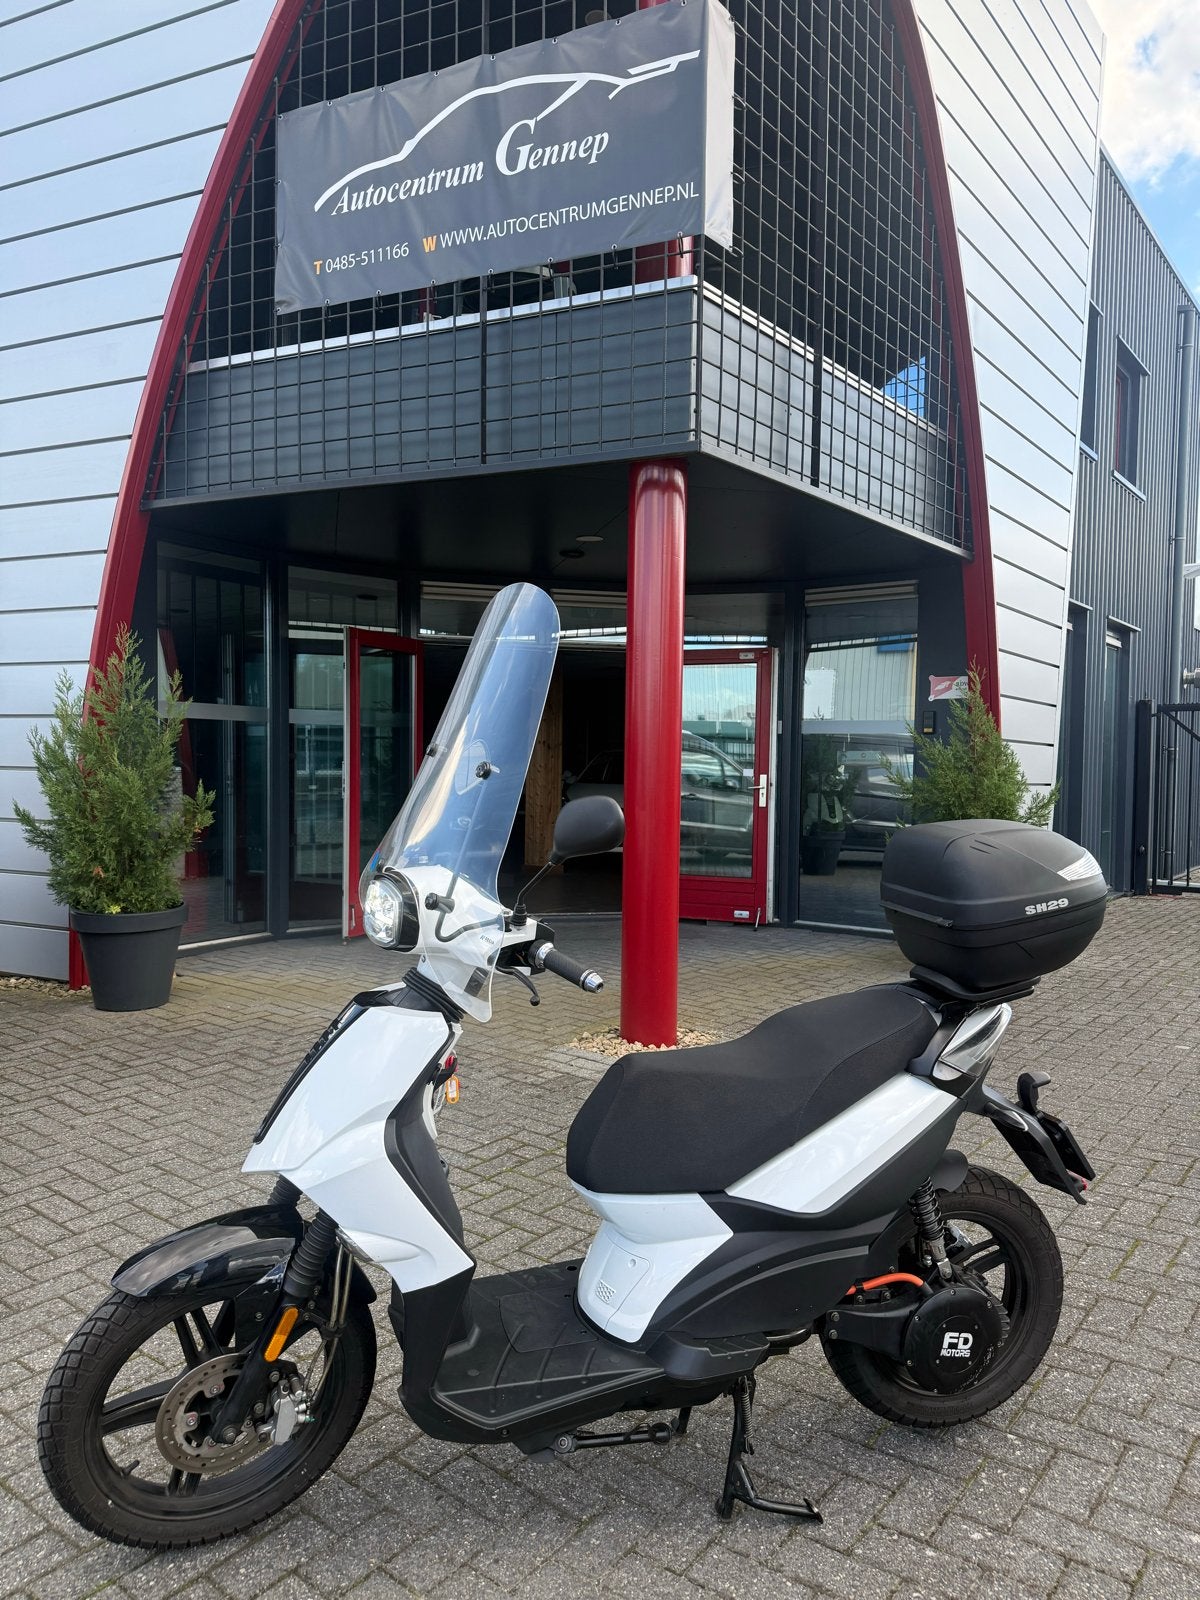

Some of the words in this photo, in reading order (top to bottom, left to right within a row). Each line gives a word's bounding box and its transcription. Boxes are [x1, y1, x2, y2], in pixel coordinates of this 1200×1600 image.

[331, 161, 484, 216] Autocentrum
[496, 118, 610, 176] Gennep
[314, 260, 323, 275] T
[325, 242, 410, 273] 0485-511166
[422, 235, 438, 254] W
[439, 181, 700, 249] WWW.AUTOCENTRUMGENNEP.NL
[1024, 898, 1069, 915] SH29
[942, 1331, 974, 1349] FD
[940, 1349, 971, 1358] MOTORS
